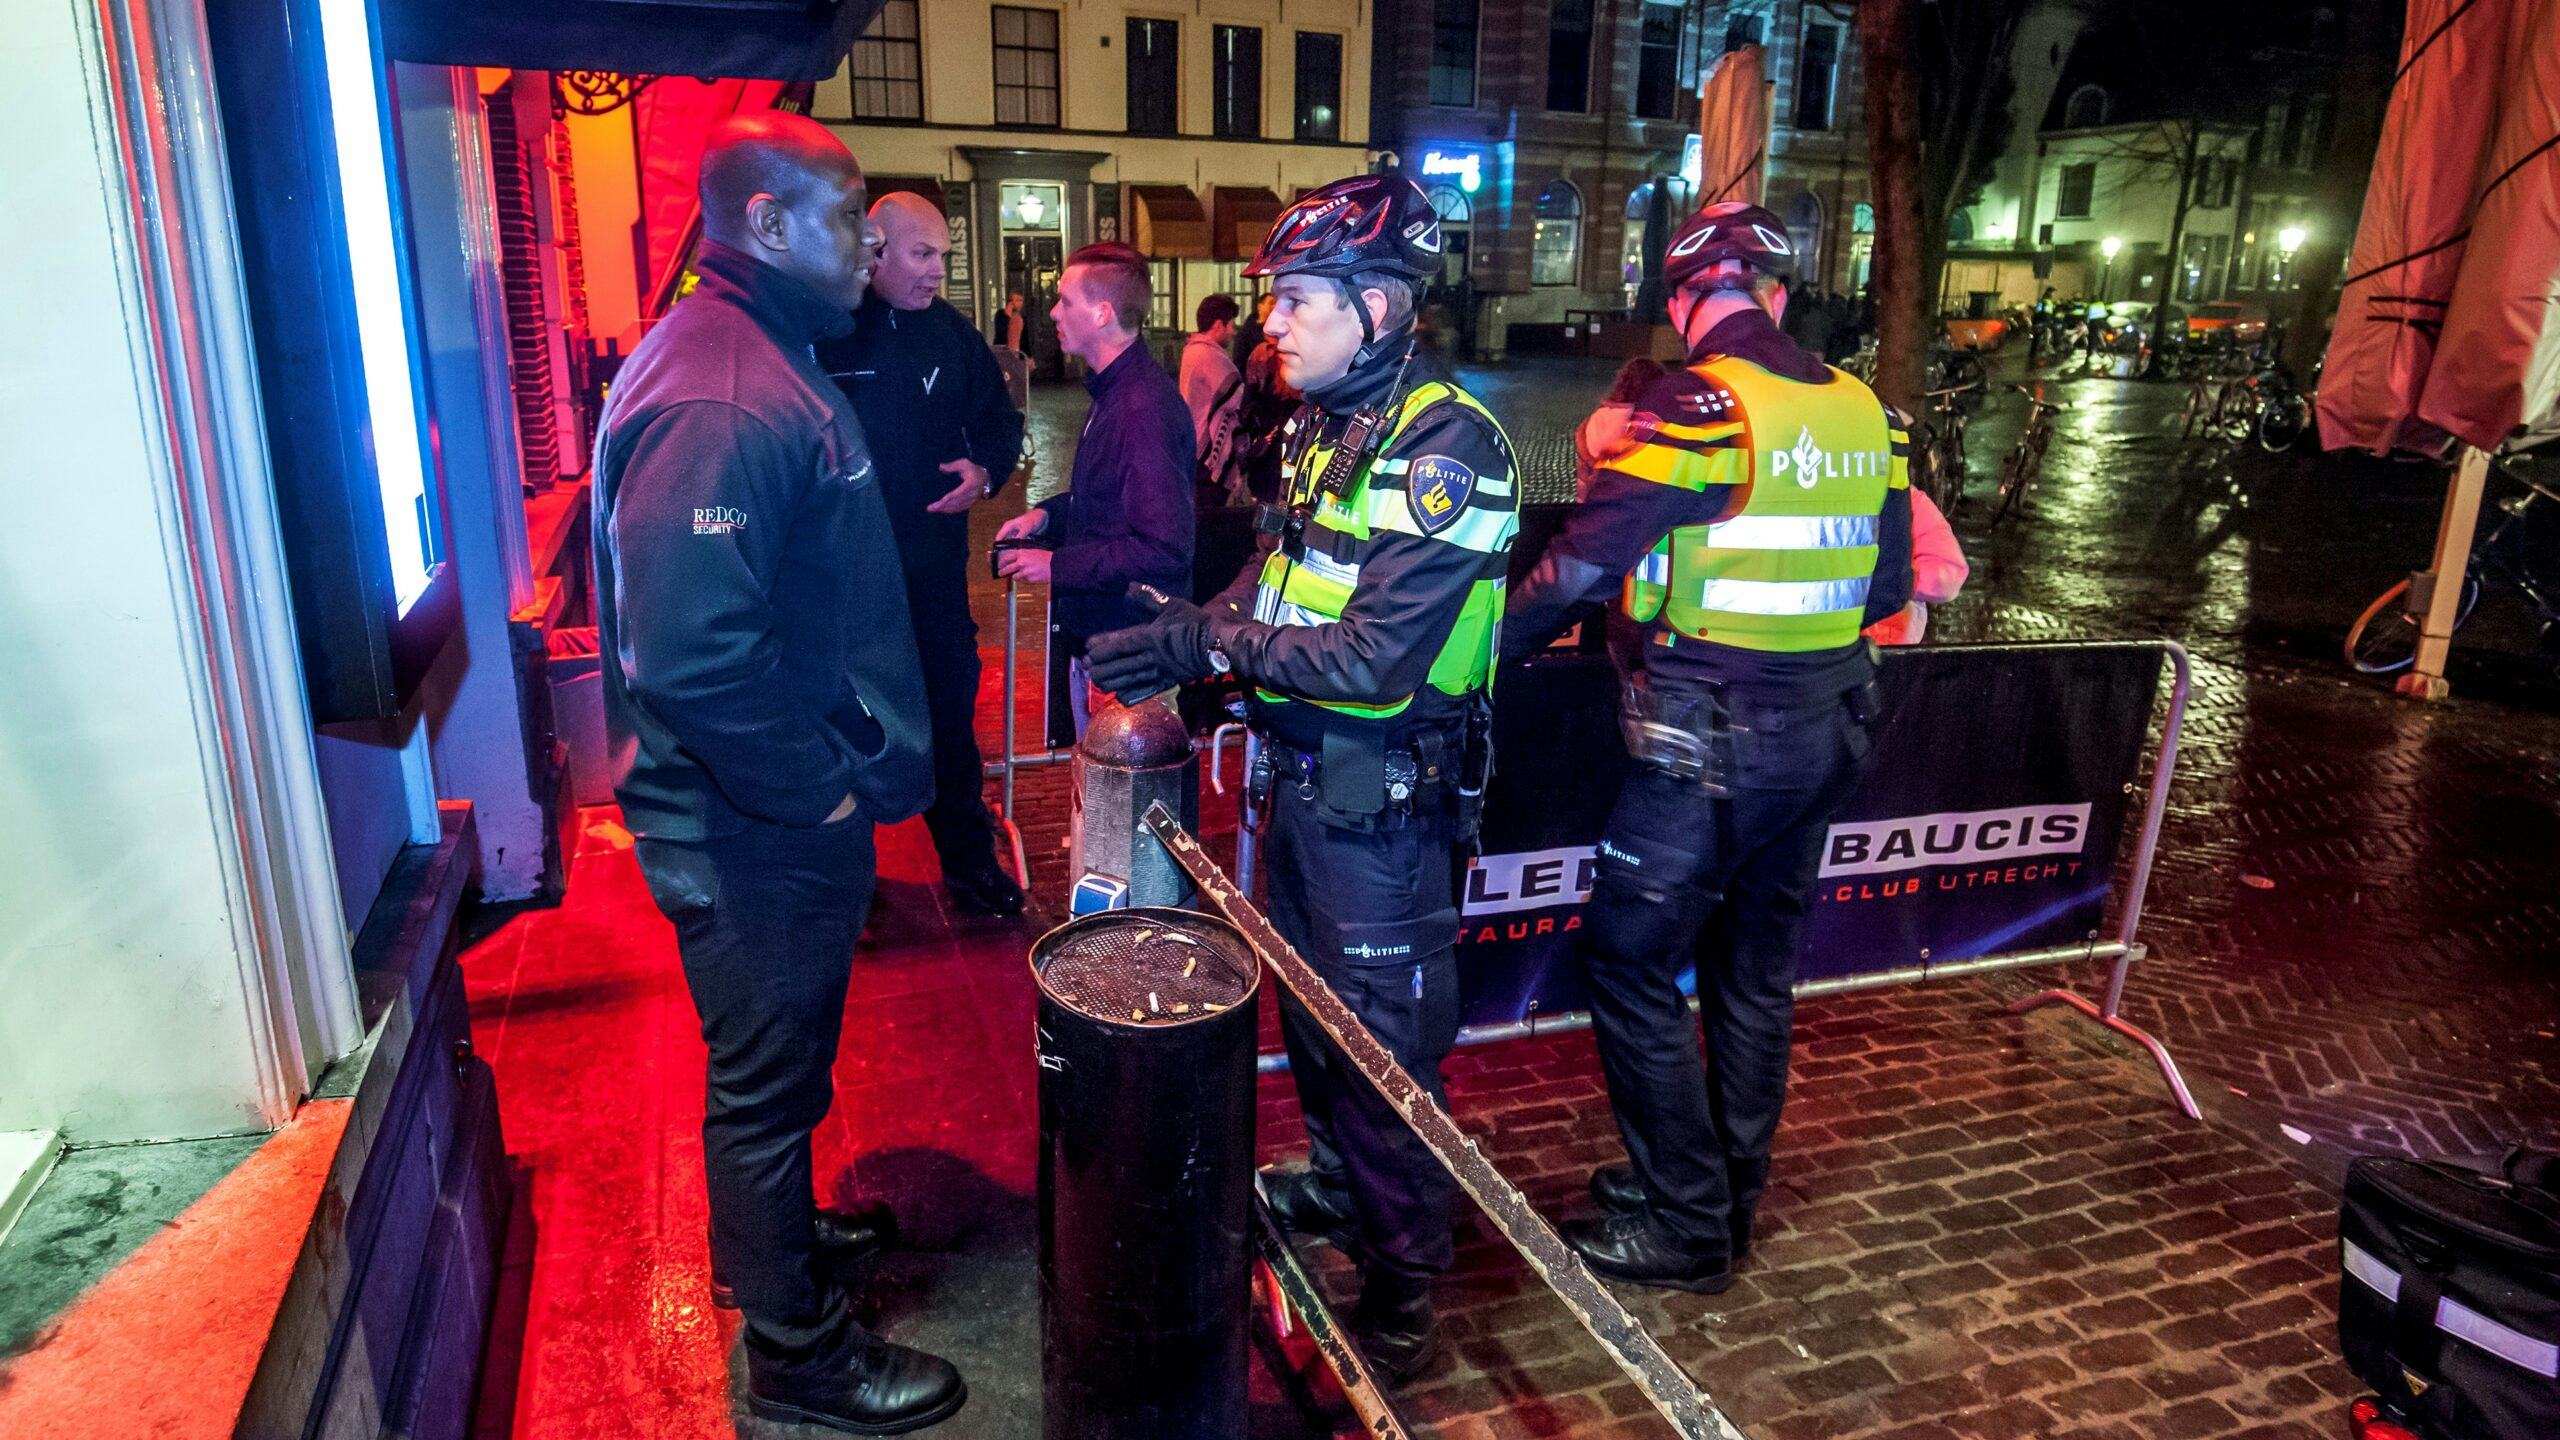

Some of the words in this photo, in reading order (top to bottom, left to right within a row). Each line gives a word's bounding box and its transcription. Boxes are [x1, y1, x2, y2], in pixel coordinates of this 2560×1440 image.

[950, 216, 968, 280] BRASS
[1417, 463, 1468, 485] POLITIE
[693, 506, 747, 526] REDCO
[693, 525, 731, 535] SECURITY
[1829, 814, 2080, 867] BAUCIS
[1835, 878, 1921, 901] CLUB
[1939, 862, 2081, 890] UTRECHT
[1456, 915, 1583, 945] TAURA
[1355, 944, 1400, 958] POLITIE
